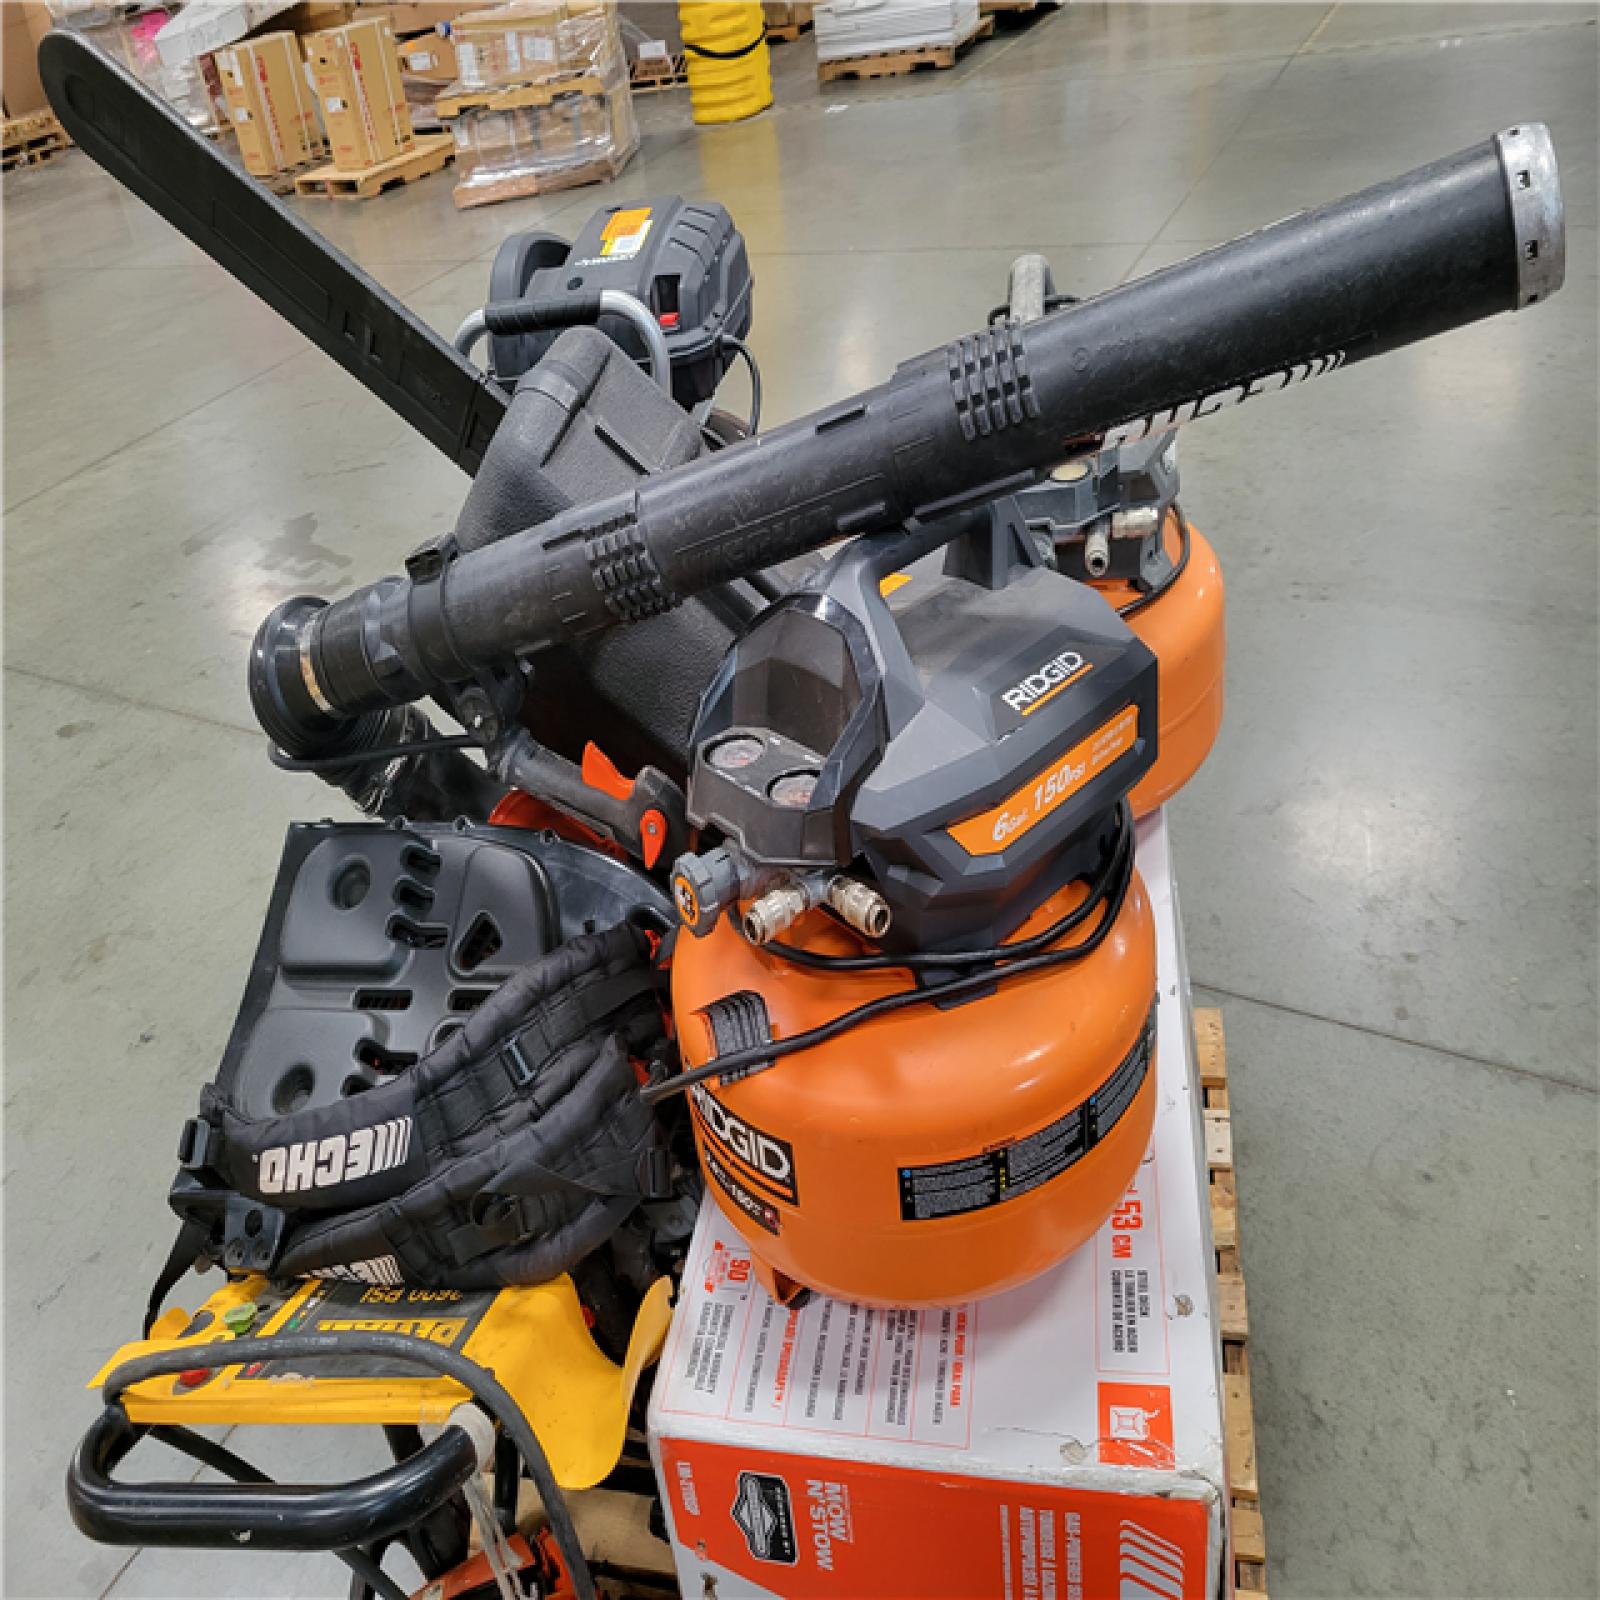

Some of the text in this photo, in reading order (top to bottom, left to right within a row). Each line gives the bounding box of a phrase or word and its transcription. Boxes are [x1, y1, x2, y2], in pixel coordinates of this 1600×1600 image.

[1002, 651, 1084, 711] RIDGID
[259, 1121, 380, 1194] ECHO
[1111, 1200, 1143, 1259] 53 CM
[727, 1259, 751, 1281] 90
[806, 1479, 833, 1571] N'STOW
[825, 1482, 846, 1541] MOW
